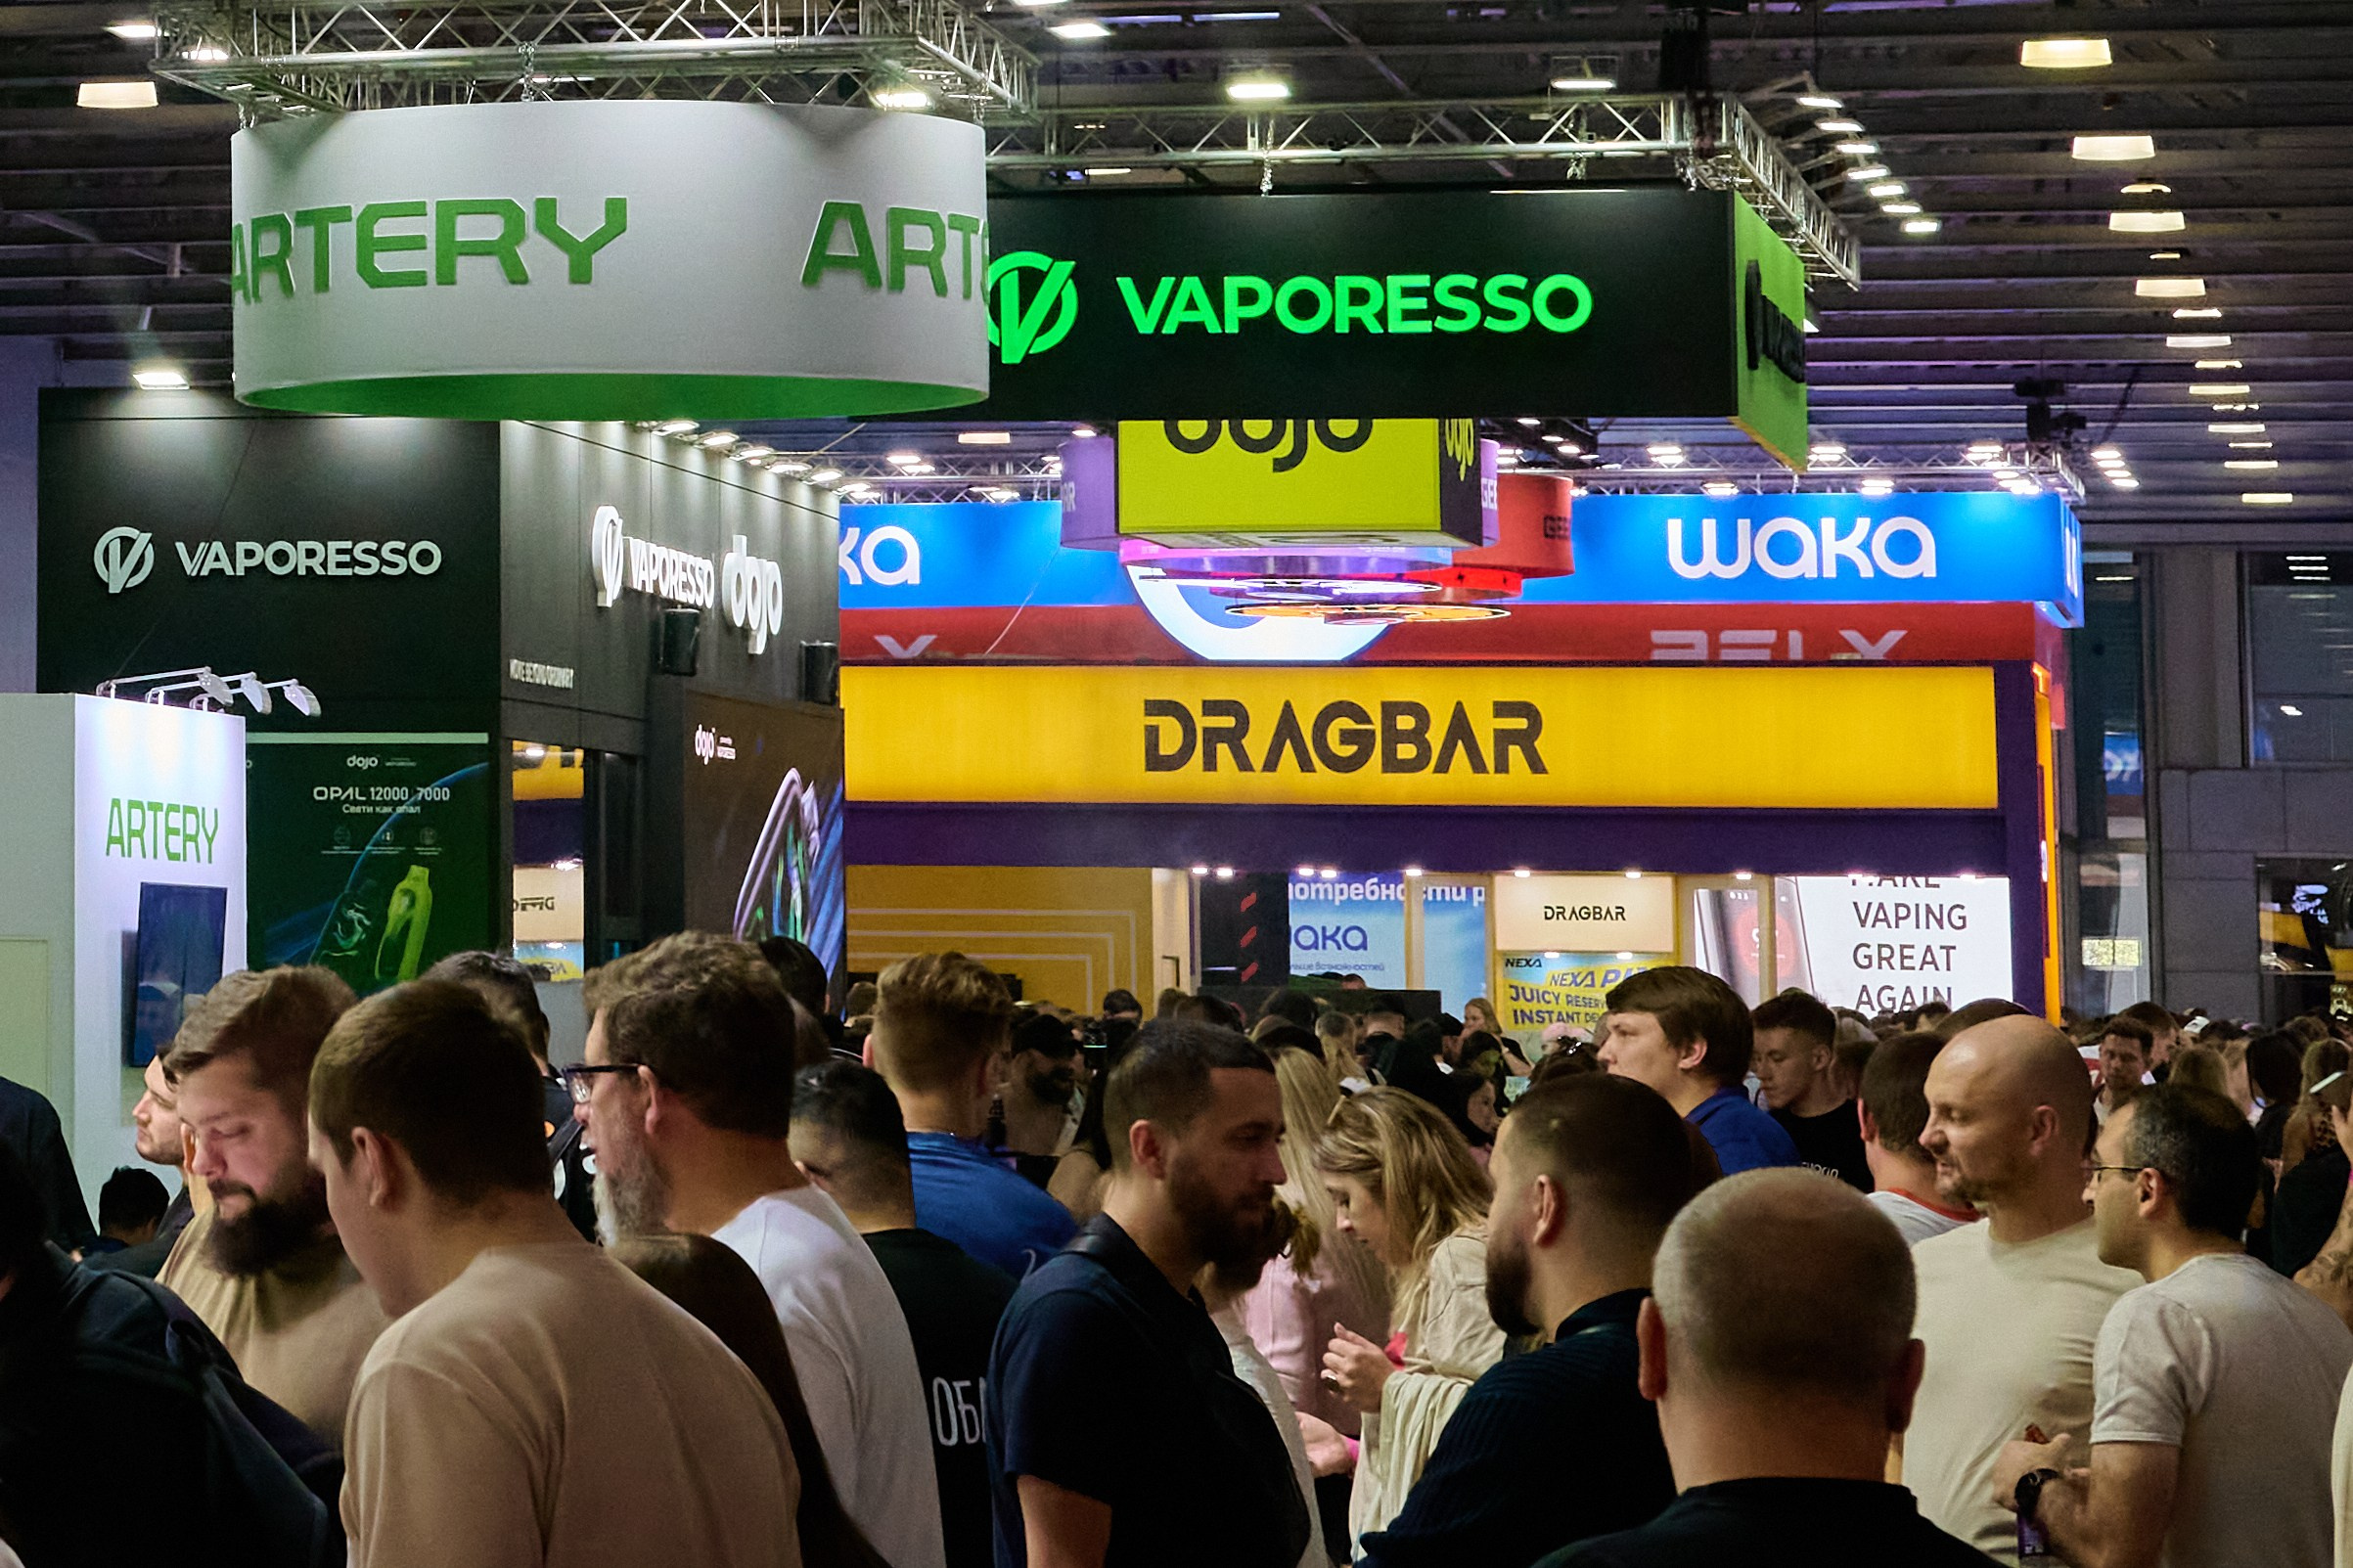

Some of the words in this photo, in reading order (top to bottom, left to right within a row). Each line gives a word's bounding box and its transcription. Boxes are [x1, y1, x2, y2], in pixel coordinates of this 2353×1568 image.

[232, 197, 627, 306] ARTERY
[801, 201, 990, 306] ART
[1116, 273, 1592, 335] VAPORESSO
[176, 540, 442, 576] VAPORESSO
[623, 537, 714, 608] VAPORESSO
[722, 535, 783, 654] dojo
[1144, 699, 1549, 774] DRAGBAR
[346, 754, 379, 770] dojo
[313, 786, 367, 800] OPAL
[369, 786, 409, 801] 12000
[416, 786, 450, 801] 7000
[106, 797, 219, 865] ARTERY
[1544, 906, 1626, 921] DRAGBAR
[1852, 901, 1967, 930] VAPING
[1289, 924, 1368, 951] aka
[1505, 958, 1542, 968] NEXA
[1852, 942, 1957, 971] GREAT
[1550, 969, 1596, 988] NEXA
[1509, 984, 1561, 1006] JUICY
[1855, 984, 1952, 1012] AGAIN
[1513, 1008, 1581, 1025] INSTANT
